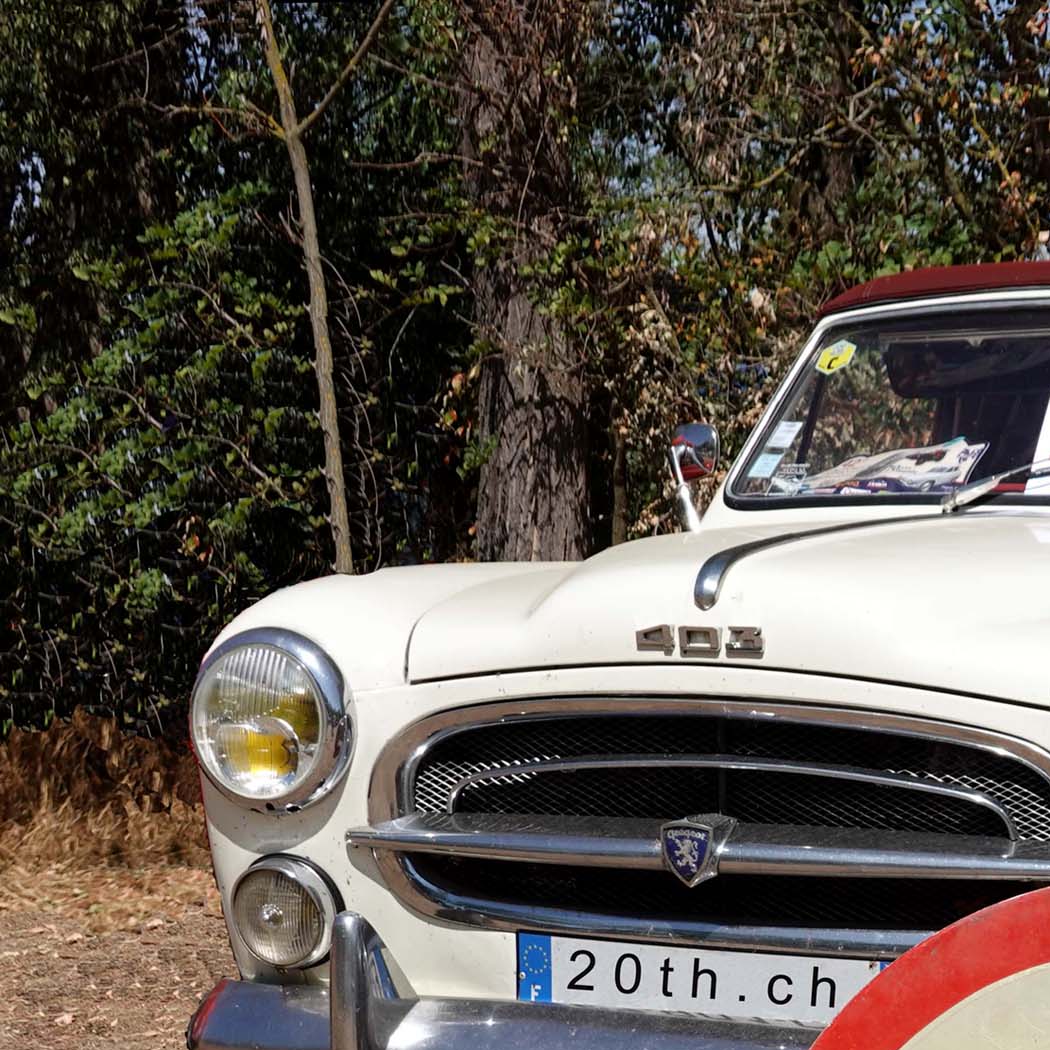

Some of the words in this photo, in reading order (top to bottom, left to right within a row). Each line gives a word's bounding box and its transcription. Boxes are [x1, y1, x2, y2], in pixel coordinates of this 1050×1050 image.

[636, 624, 765, 659] 403
[530, 983, 542, 1002] F
[566, 949, 837, 1009] 20th.ch
